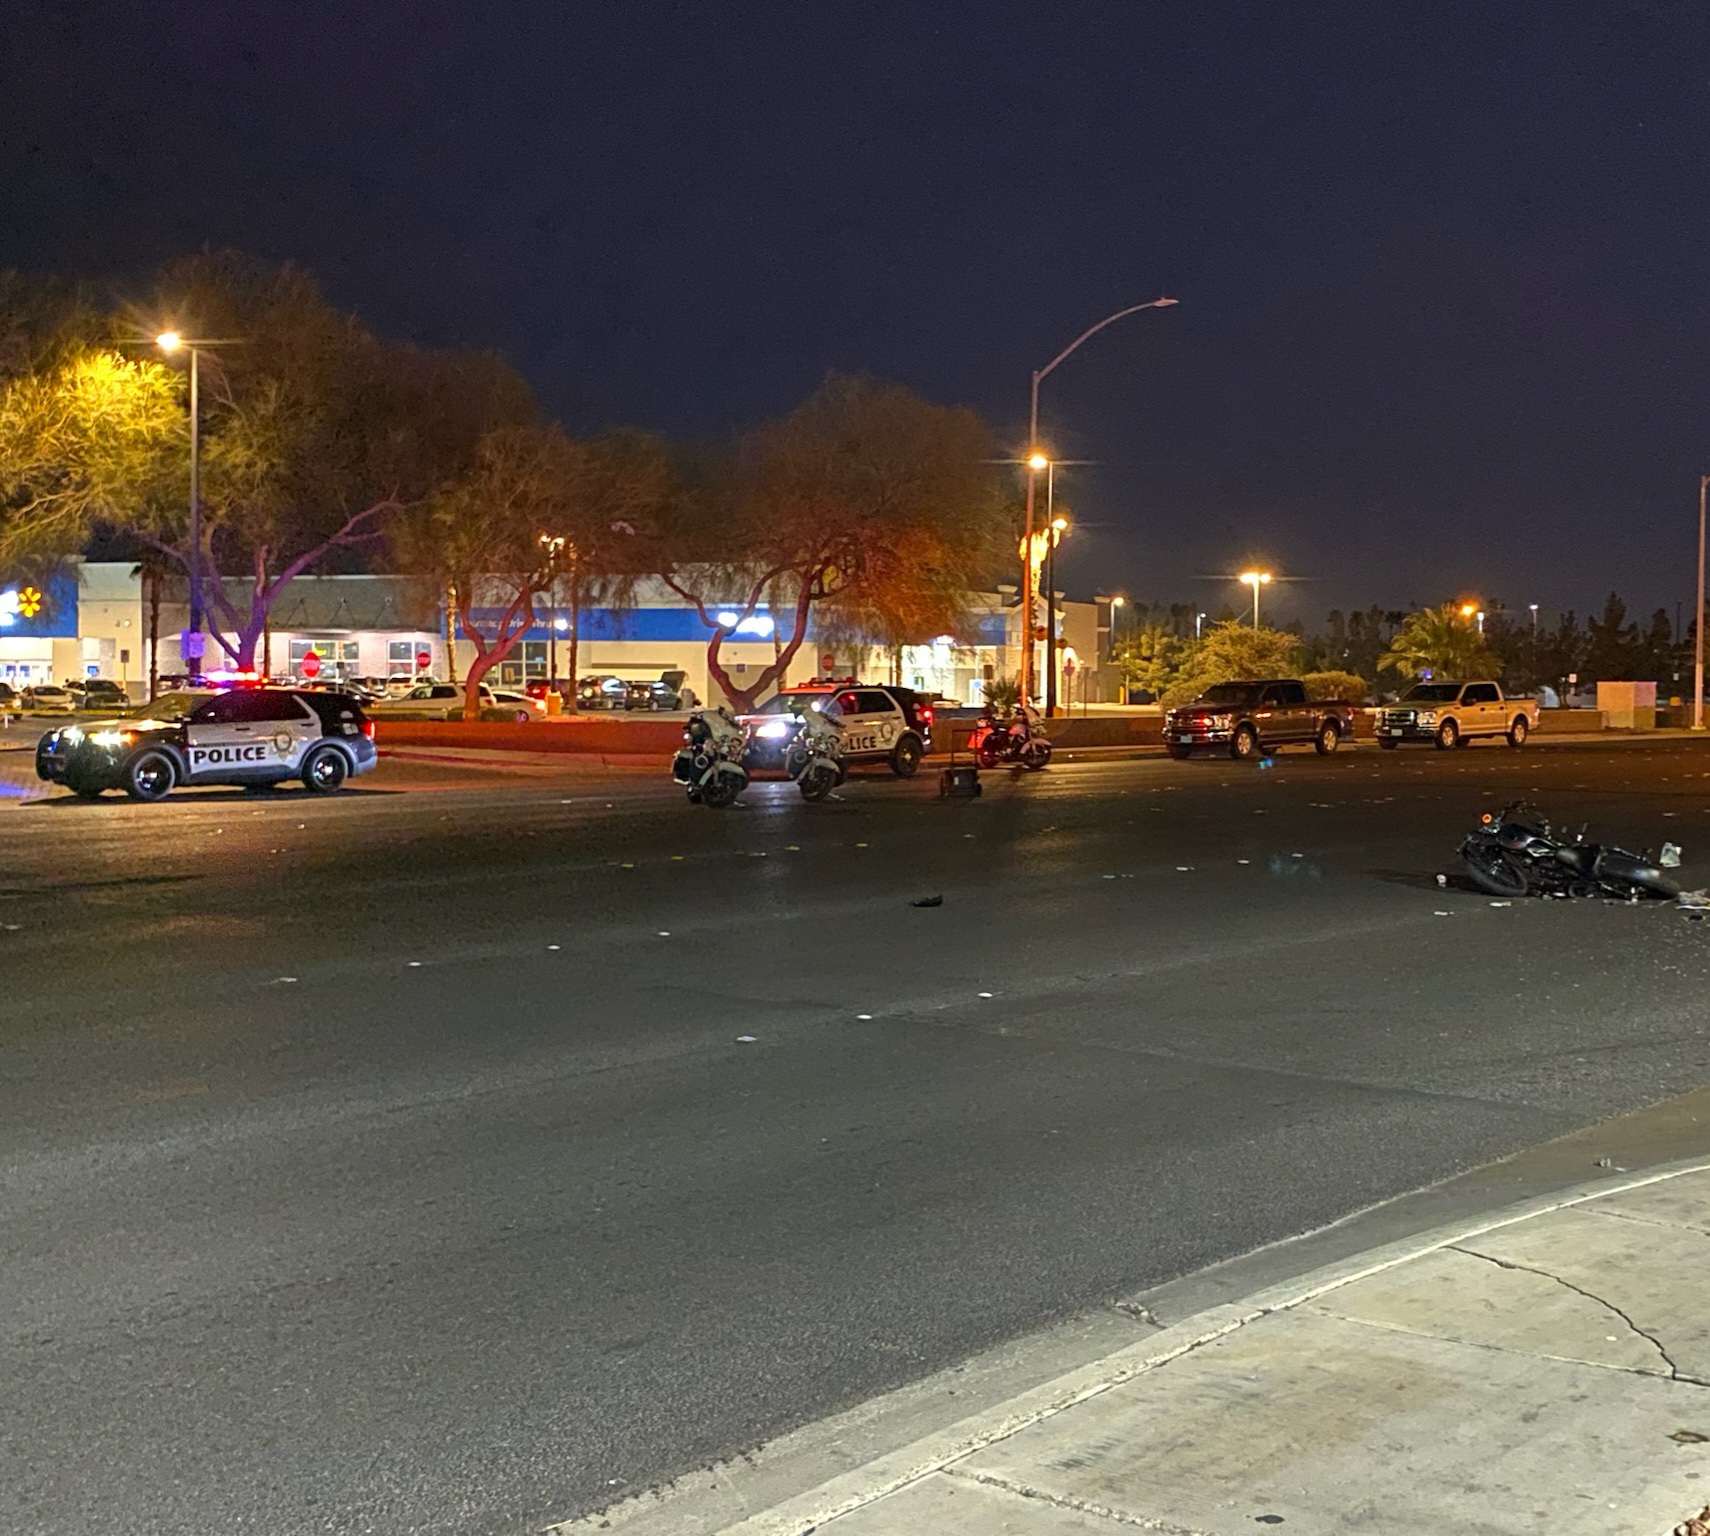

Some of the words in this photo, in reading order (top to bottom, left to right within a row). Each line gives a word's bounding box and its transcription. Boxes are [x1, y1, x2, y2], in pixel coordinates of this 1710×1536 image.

[303, 659, 319, 669] STOP
[849, 736, 877, 750] LICE
[194, 747, 266, 763] POLICE
